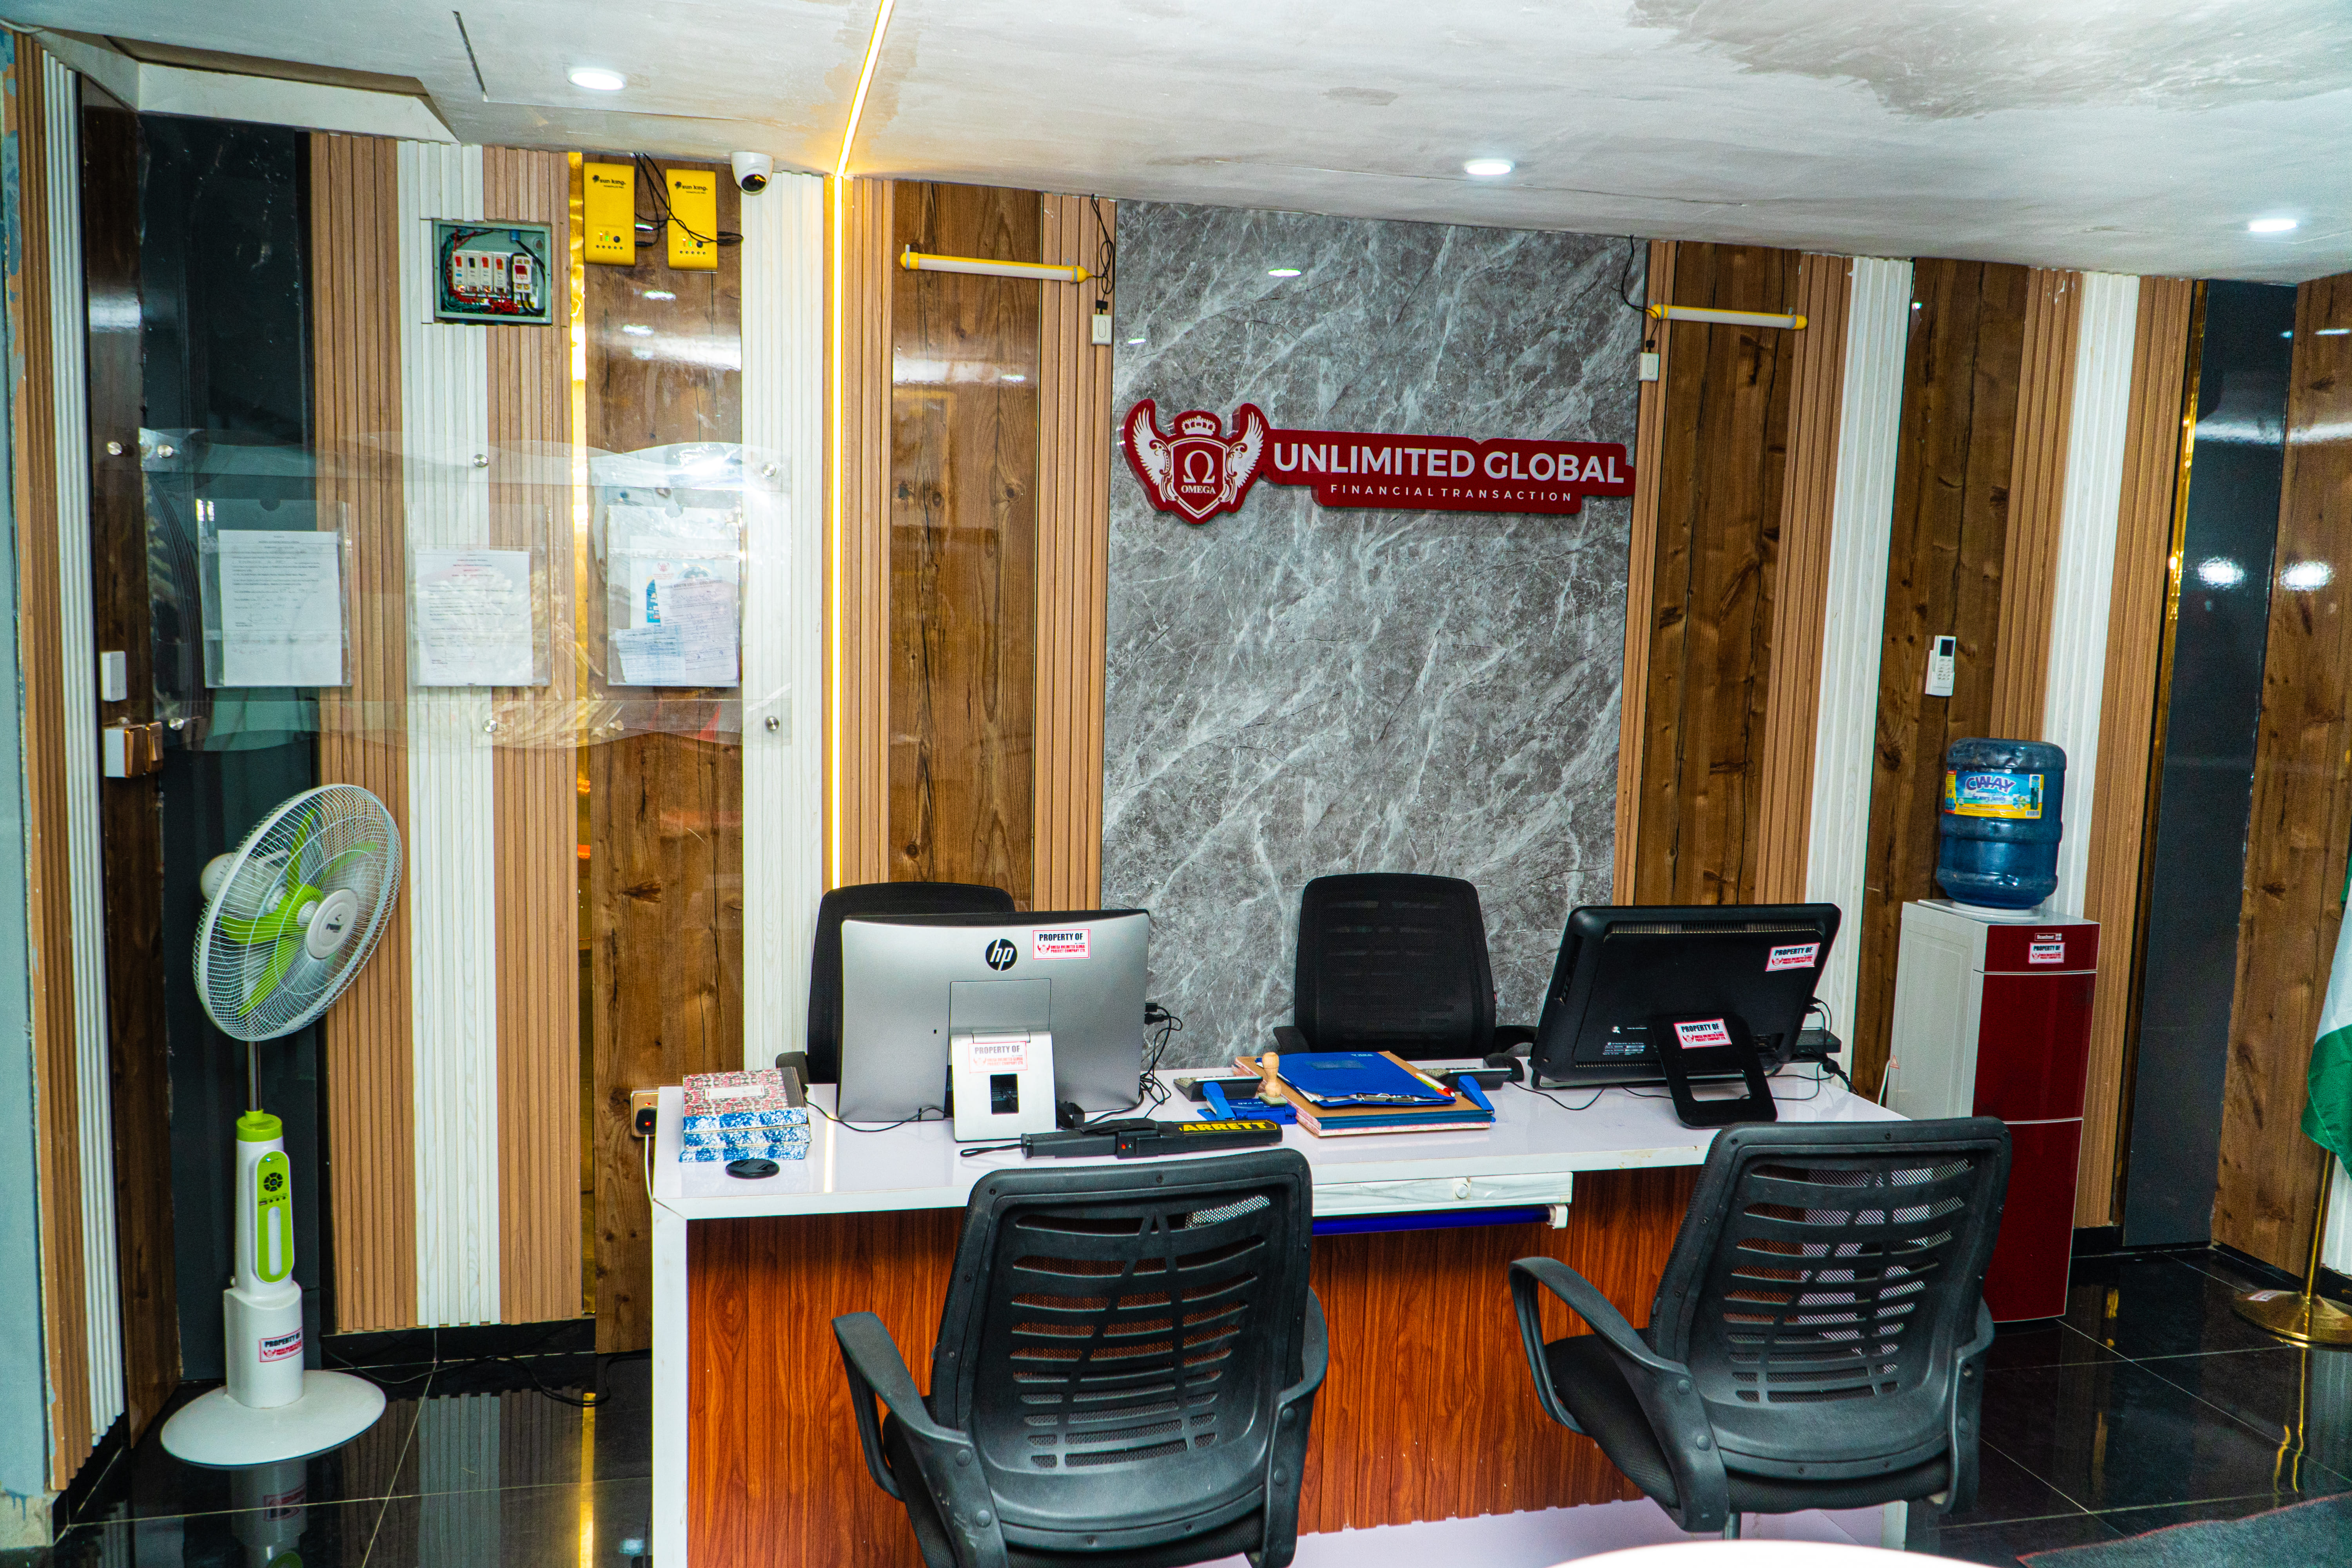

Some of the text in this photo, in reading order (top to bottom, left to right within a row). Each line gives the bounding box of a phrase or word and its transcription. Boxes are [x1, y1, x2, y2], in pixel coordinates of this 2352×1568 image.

[1274, 443, 1624, 483] UNLIMITED GLOBAL
[1181, 485, 1216, 494] OMEGA
[1331, 484, 1571, 501] FINANCIAL TRANSACTION
[1966, 776, 2016, 793] CWAY
[990, 939, 1014, 971] hp
[1775, 947, 1805, 956] PROPERTY
[1681, 1024, 1711, 1033] PROPERTY
[975, 1046, 1010, 1054] PROPERTY
[1179, 1122, 1267, 1131] ARRETT
[264, 1334, 296, 1348] PROPERTY
